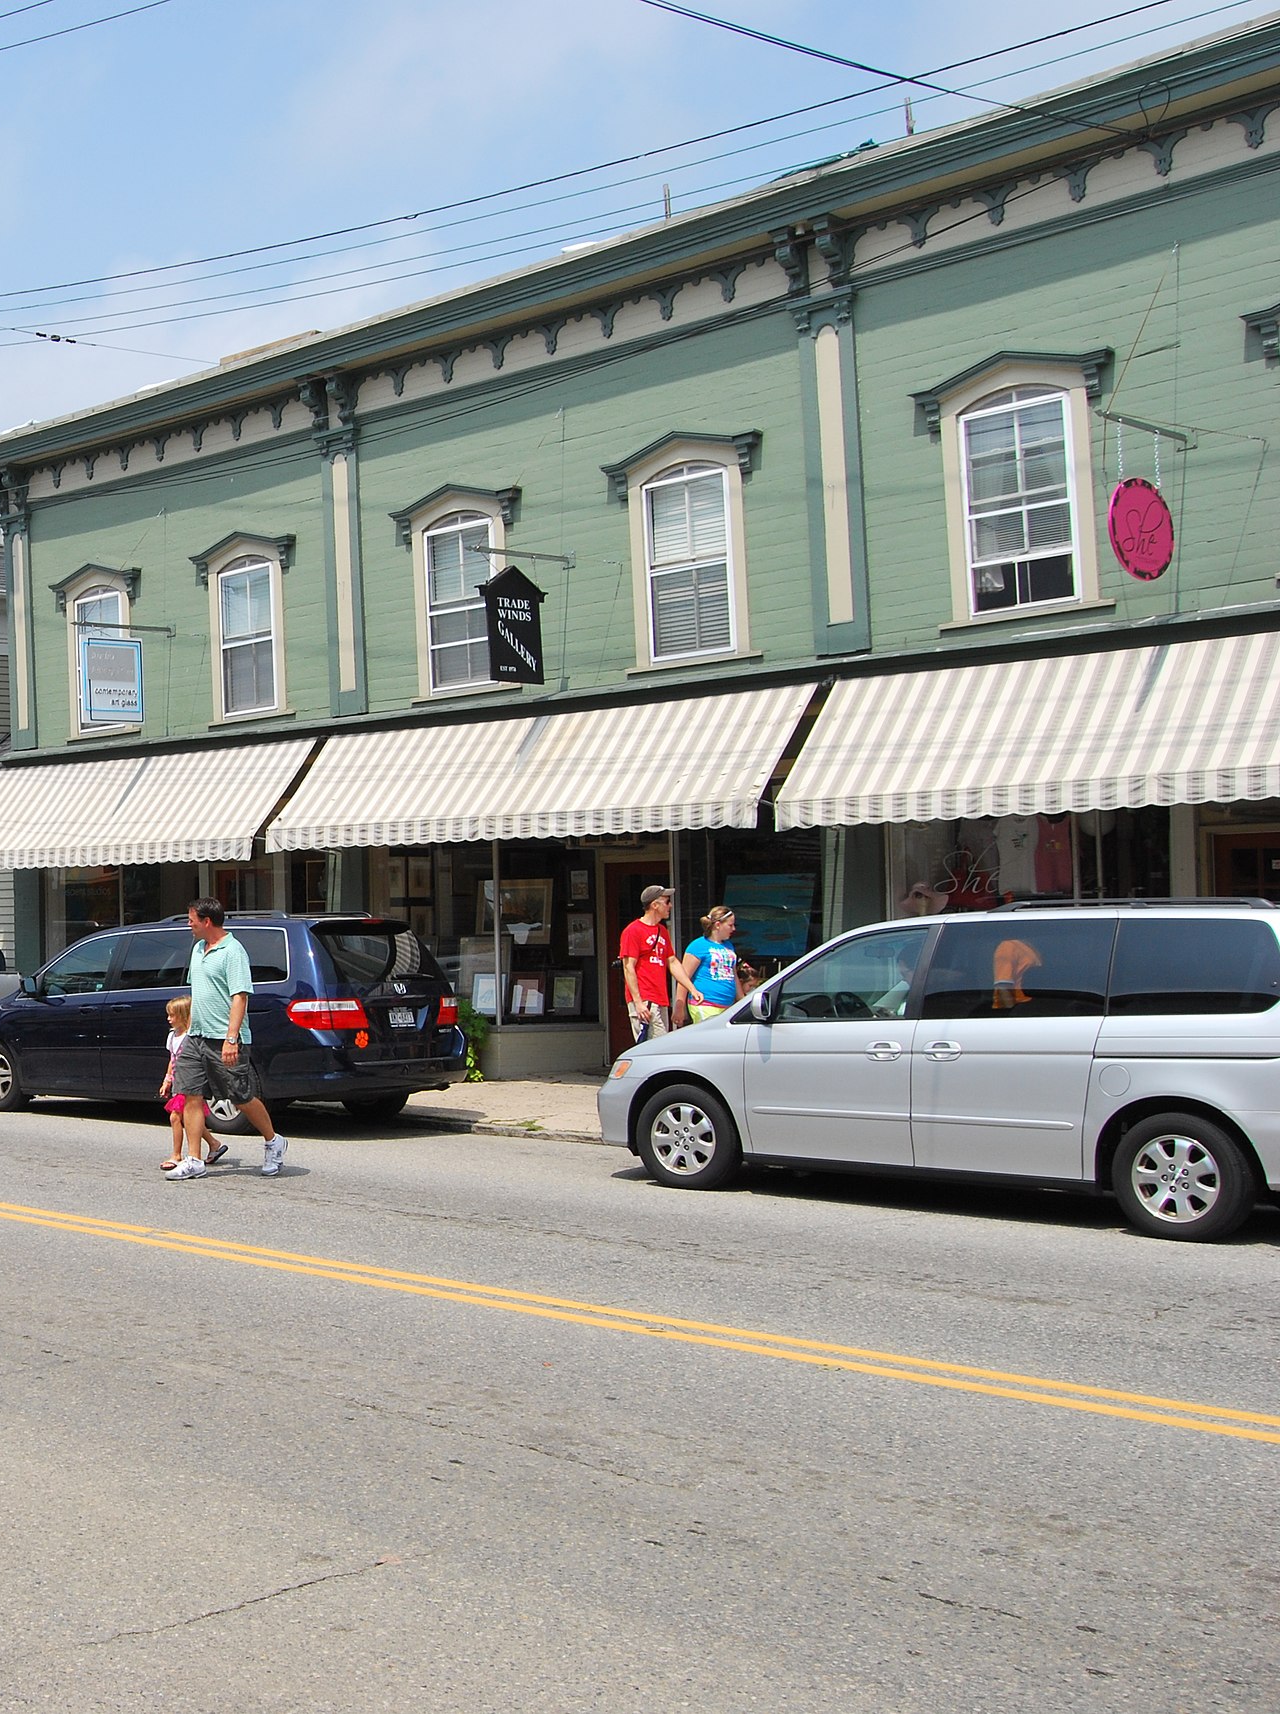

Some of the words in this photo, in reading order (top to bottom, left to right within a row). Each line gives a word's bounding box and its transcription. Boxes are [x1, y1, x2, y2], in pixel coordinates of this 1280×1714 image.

[497, 597, 530, 610] TRADE
[498, 609, 532, 622] WINDS
[497, 620, 537, 672] GALLERY
[95, 688, 137, 698] contemporary
[121, 698, 138, 707] glass
